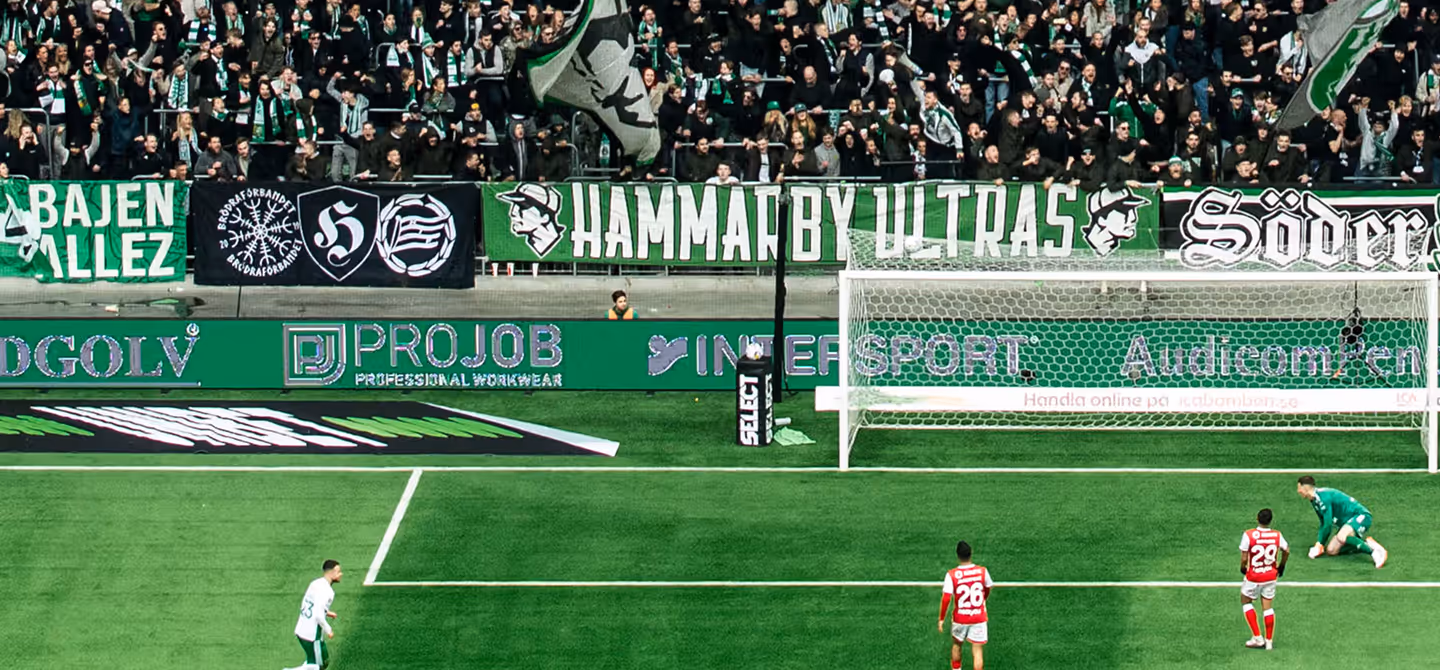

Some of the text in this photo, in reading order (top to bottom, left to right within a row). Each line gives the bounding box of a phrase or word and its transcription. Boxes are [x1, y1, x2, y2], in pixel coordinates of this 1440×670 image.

[29, 182, 175, 228] BAJEN
[570, 183, 1078, 263] HAMMARBY ULTRAS
[1181, 187, 1429, 270] Söder
[39, 232, 175, 278] ALLEZ
[354, 323, 563, 368] PROJOB
[355, 373, 563, 387] PROFESSIONAL WORKWEAR
[1024, 392, 1088, 407] Handla
[1090, 392, 1142, 407] online
[739, 374, 759, 446] SELECT
[1251, 544, 1277, 567] 29
[956, 582, 984, 608] 26
